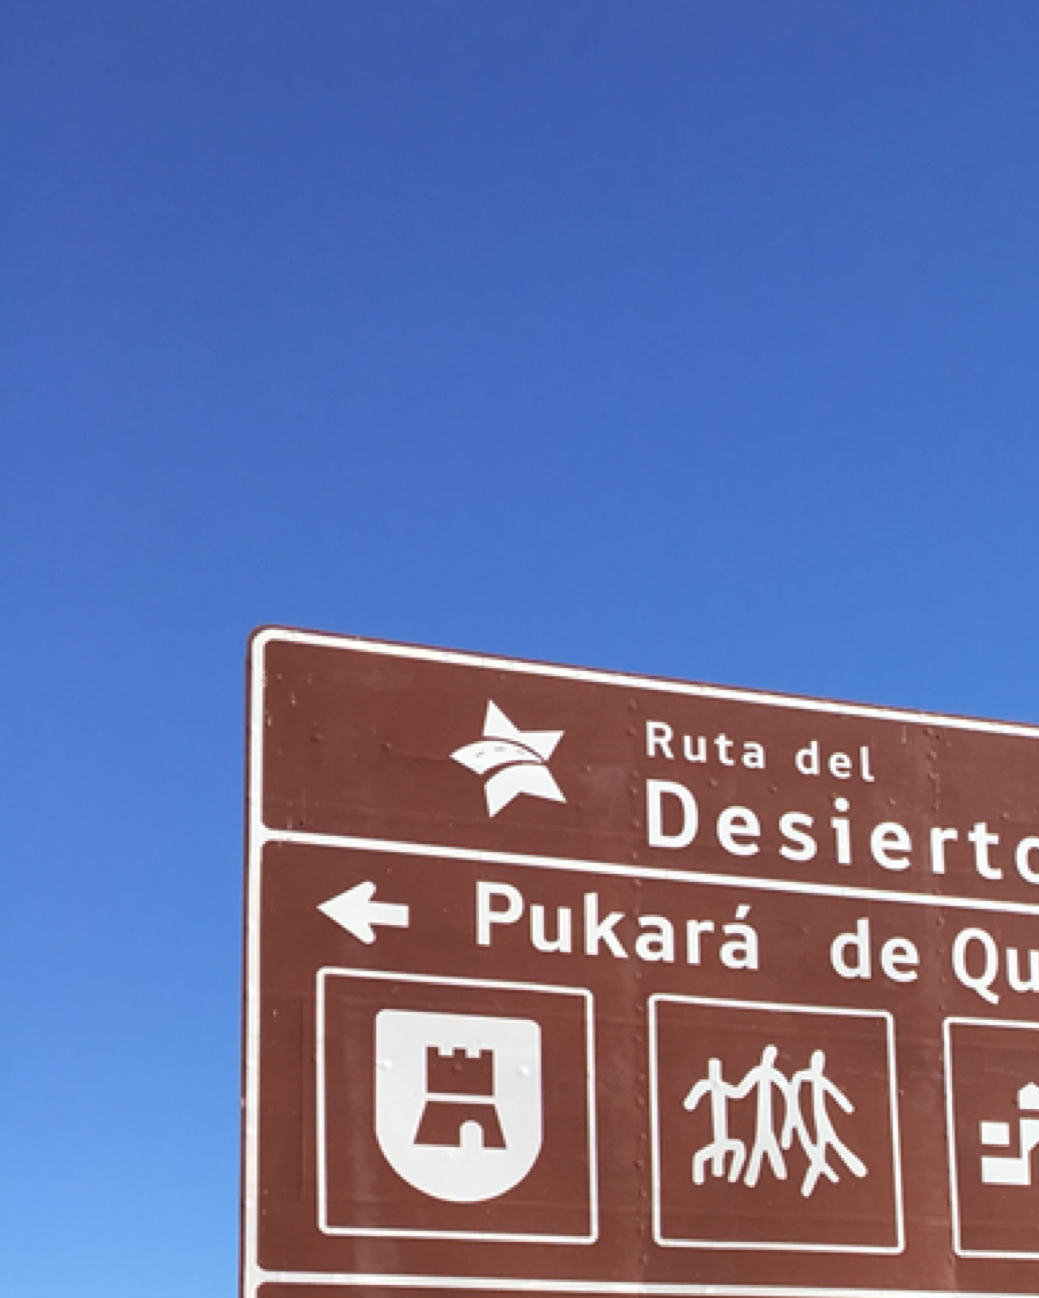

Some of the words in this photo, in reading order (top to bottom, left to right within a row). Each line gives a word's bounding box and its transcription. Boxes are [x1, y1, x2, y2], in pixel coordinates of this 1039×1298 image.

[645, 720, 767, 770] Ruta
[795, 740, 875, 783] del
[475, 880, 760, 970] Pukará
[830, 917, 920, 983] de
